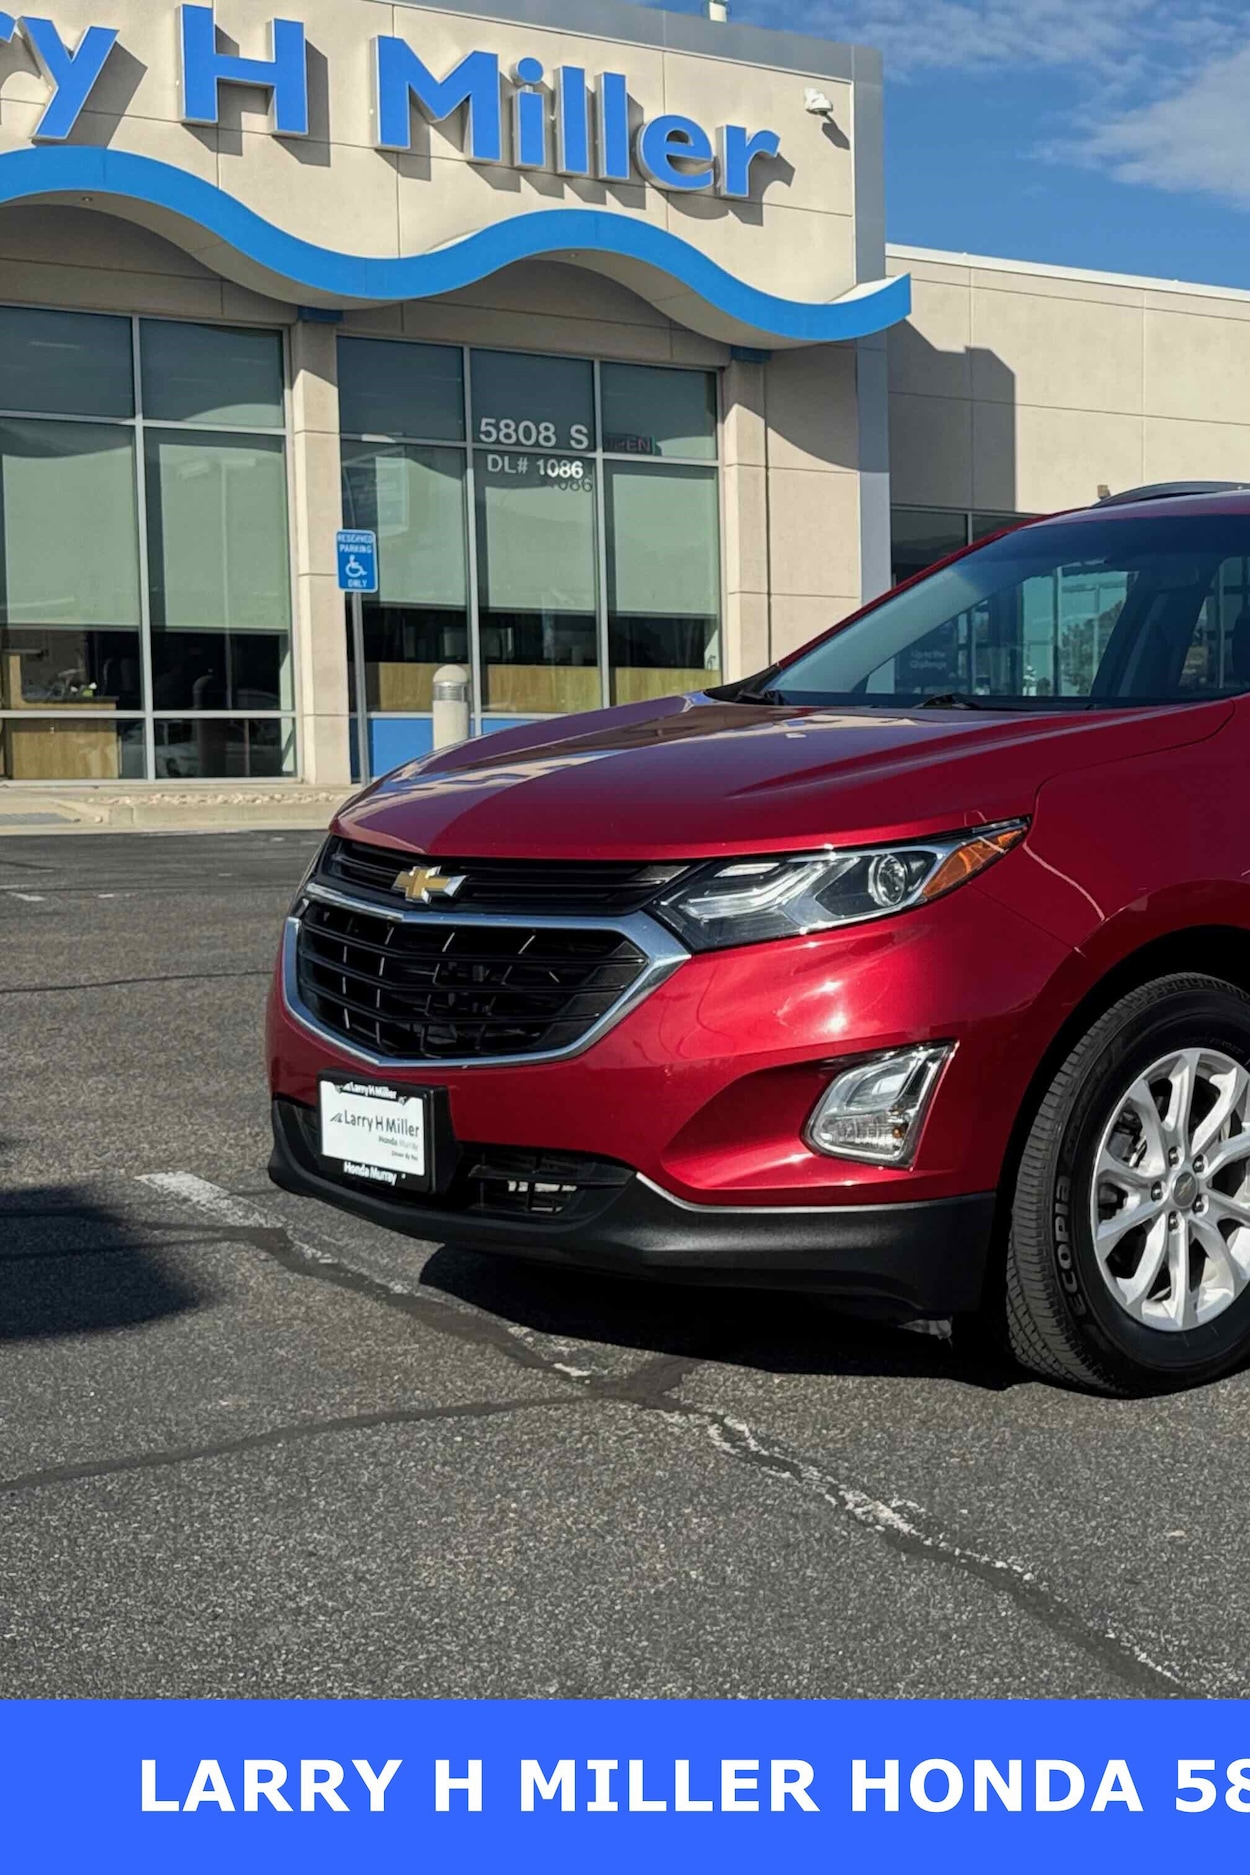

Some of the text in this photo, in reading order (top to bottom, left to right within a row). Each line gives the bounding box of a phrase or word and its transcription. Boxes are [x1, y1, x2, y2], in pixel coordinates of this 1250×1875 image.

[176, 3, 308, 135] H
[370, 35, 781, 198] Miller
[479, 417, 589, 449] 5808 S
[487, 454, 584, 478] DL# 1086
[339, 543, 373, 554] PARKING
[344, 1109, 419, 1138] Larry H Miller
[343, 1161, 397, 1187] Honda Murray
